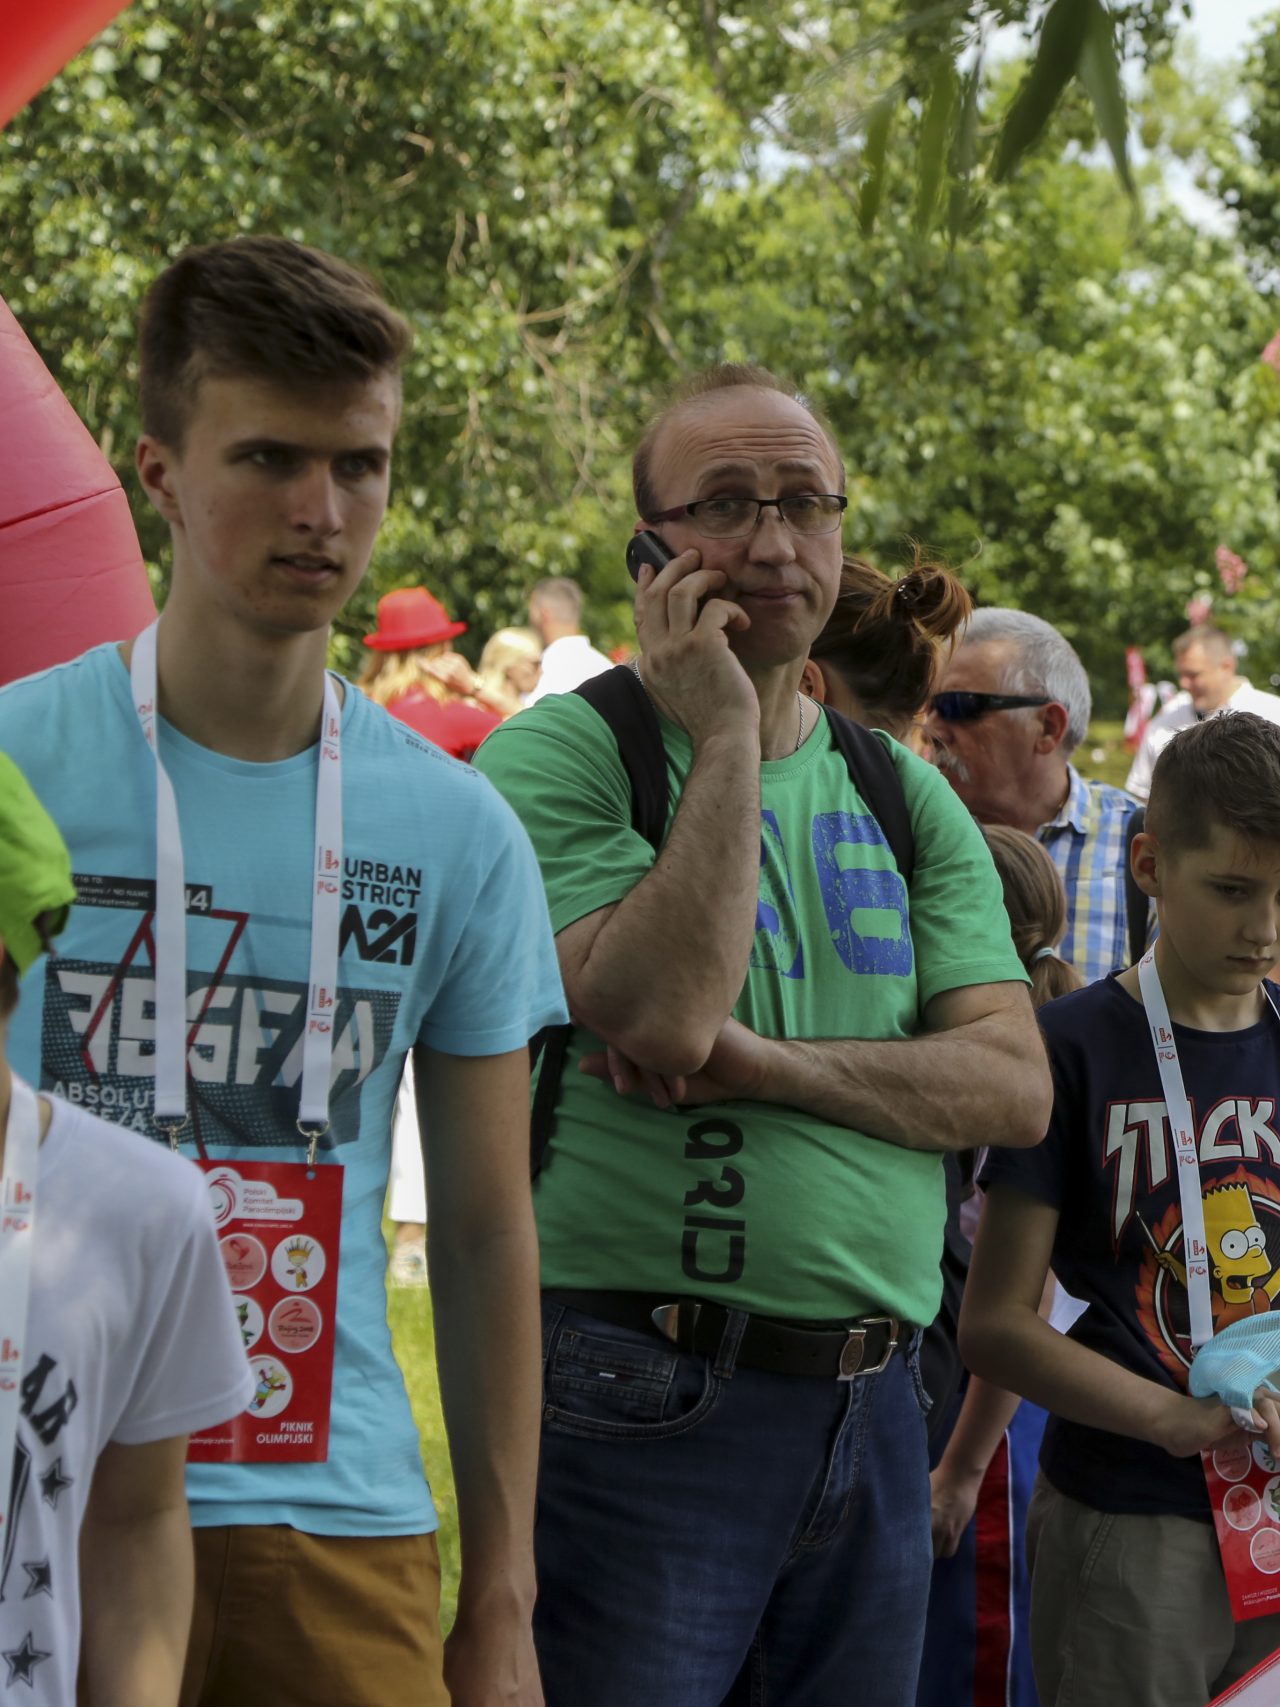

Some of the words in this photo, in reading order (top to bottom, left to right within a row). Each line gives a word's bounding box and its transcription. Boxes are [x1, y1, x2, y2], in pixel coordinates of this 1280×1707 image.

[344, 857, 422, 888] URBAN
[752, 809, 915, 979] 6
[54, 1080, 156, 1109] ABSOLU
[256, 1434, 313, 1445] OLIMPIJSKI
[280, 1421, 314, 1432] PIKNIK
